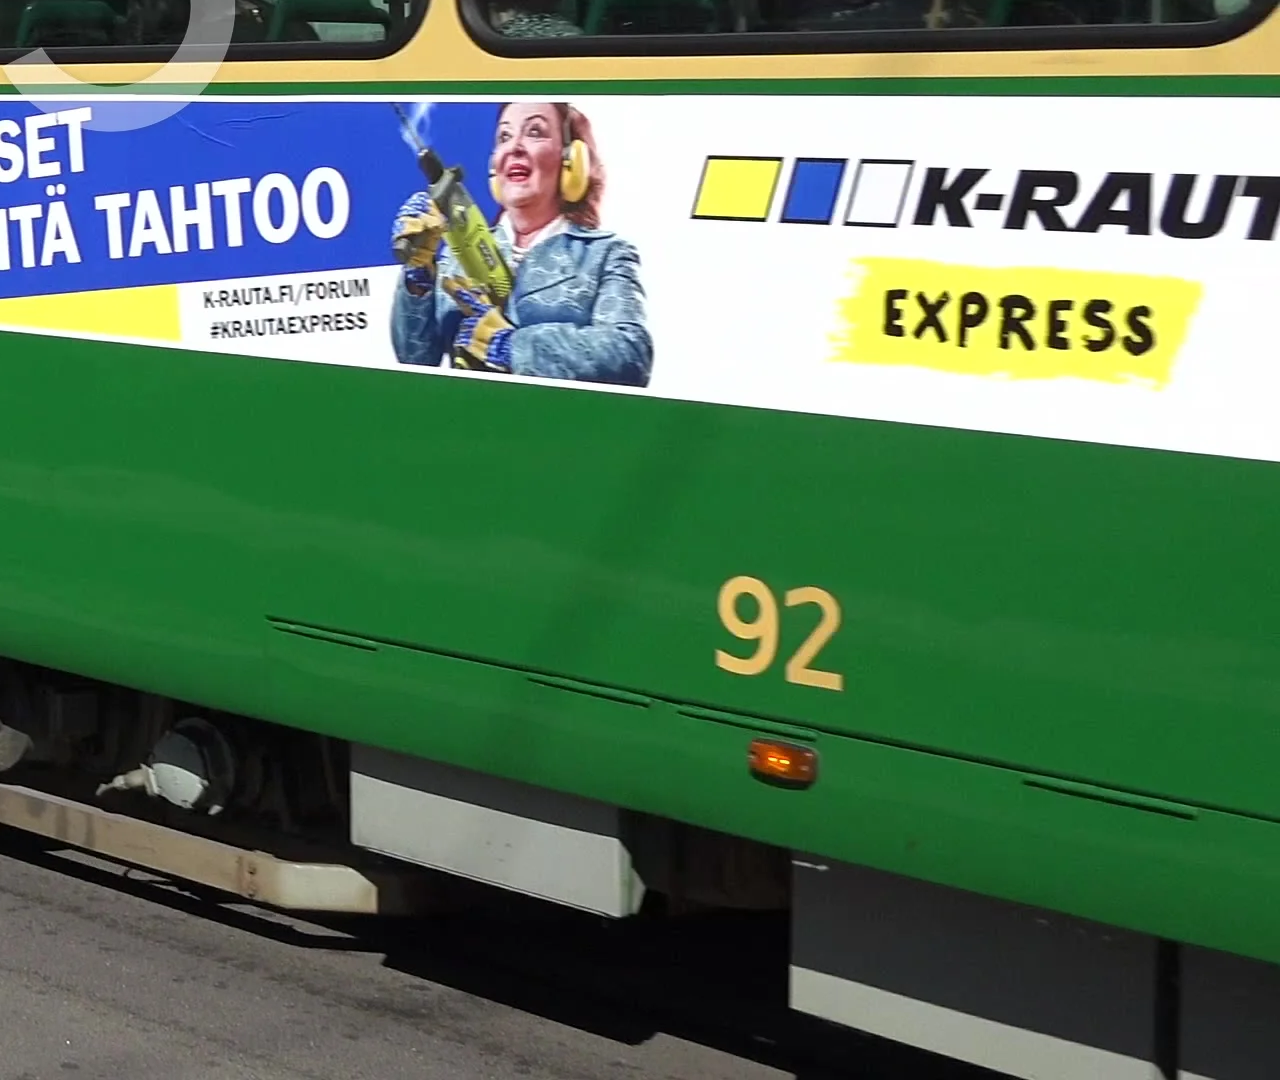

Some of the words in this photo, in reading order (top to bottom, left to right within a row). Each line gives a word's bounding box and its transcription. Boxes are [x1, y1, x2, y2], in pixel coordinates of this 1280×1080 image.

[94, 166, 350, 261] TAHTOO
[912, 166, 1280, 241] K-RAUT
[203, 278, 371, 308] K-RAUTA.FI/FORUM
[209, 311, 368, 340] #KRAUTAEXPRESS
[882, 288, 1157, 357] EXPRESS
[713, 575, 844, 692] 92
